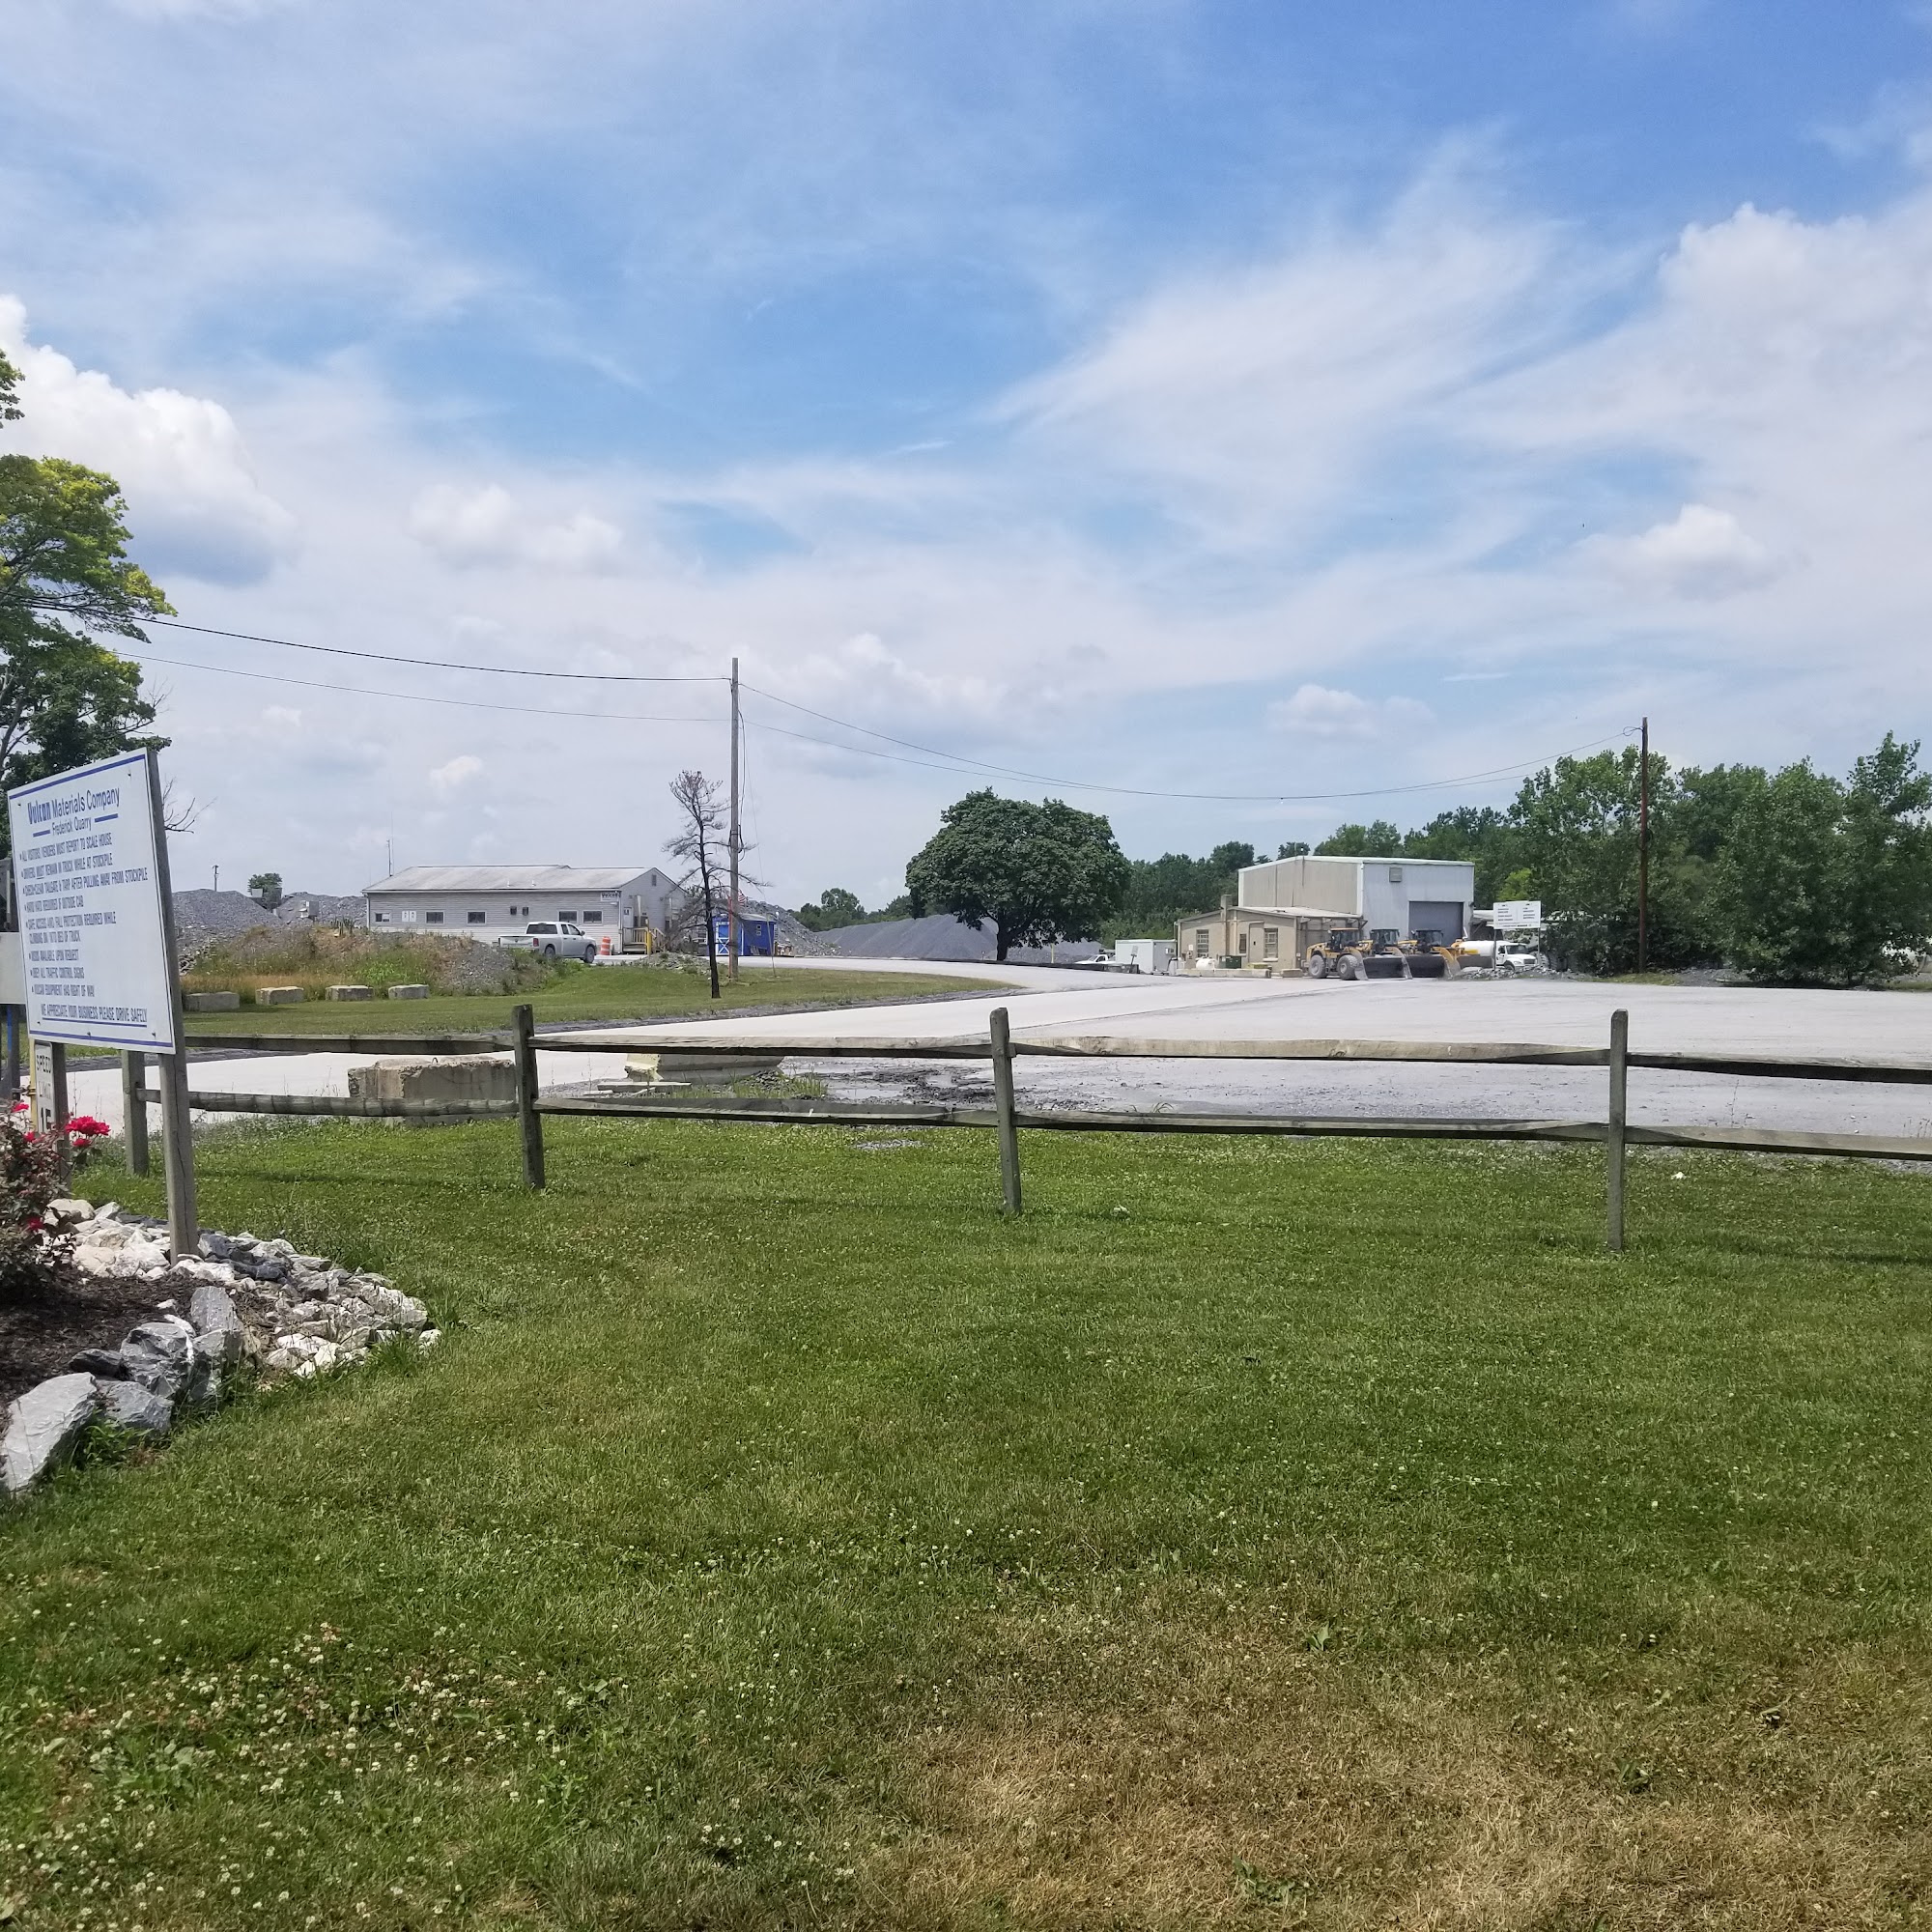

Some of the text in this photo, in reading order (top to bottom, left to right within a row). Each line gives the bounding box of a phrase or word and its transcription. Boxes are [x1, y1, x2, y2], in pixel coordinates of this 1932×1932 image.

[28, 788, 119, 824] Vulcan Materials Company
[52, 817, 91, 836] Frederick Quarry
[66, 839, 79, 852] REPORT
[80, 838, 85, 850] TO
[86, 835, 98, 849] SCALE
[99, 833, 112, 847] HOUSE
[74, 857, 85, 871] WHILE
[87, 856, 91, 869] AT
[92, 853, 112, 868] STOCKPILE
[71, 877, 83, 889] AFTER
[83, 874, 99, 888] PULLING
[100, 872, 110, 886] AWAY
[112, 871, 124, 884] FROM
[125, 867, 148, 883] STOCKPILE
[84, 912, 103, 926] REQUIRED
[103, 911, 116, 924] WHILE
[68, 930, 81, 942] TRUCK
[70, 985, 80, 996] RIGHT
[81, 985, 86, 997] OF
[47, 1004, 68, 1017] APPRECIATE
[78, 1006, 98, 1019] BUSINESS
[99, 1006, 114, 1020] PLEASE
[115, 1007, 130, 1021] DRIVE
[131, 1008, 147, 1022] SAFELY
[36, 1054, 51, 1073] SPEED
[39, 1081, 51, 1099] LIMIT
